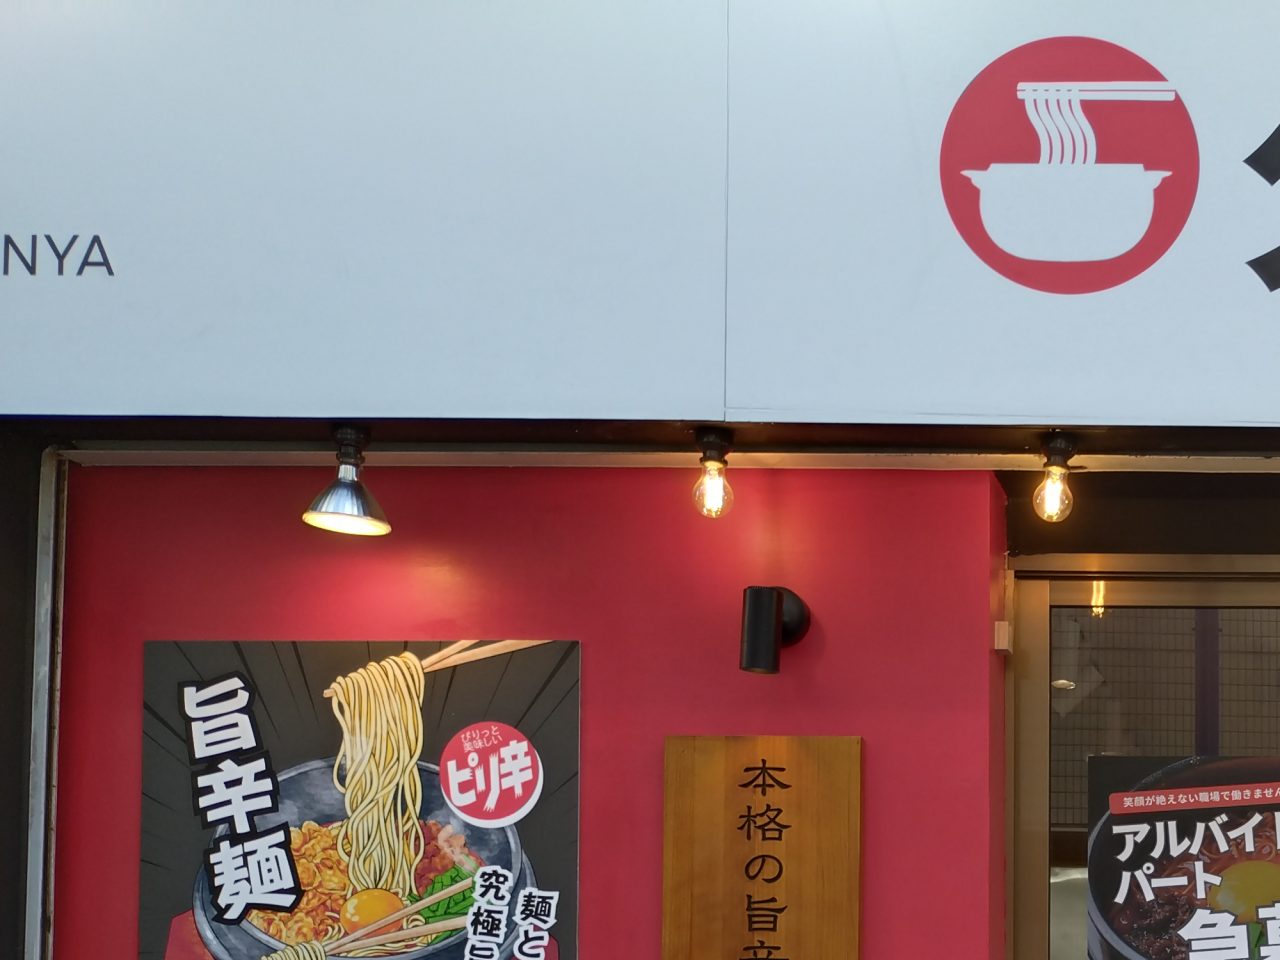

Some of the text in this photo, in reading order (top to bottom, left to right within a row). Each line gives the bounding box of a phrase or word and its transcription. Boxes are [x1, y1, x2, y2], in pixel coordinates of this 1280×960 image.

[3, 234, 115, 276] NYA
[182, 676, 297, 918] 旨辛麺
[446, 740, 534, 813] ピリ辛
[1114, 861, 1222, 904] パート
